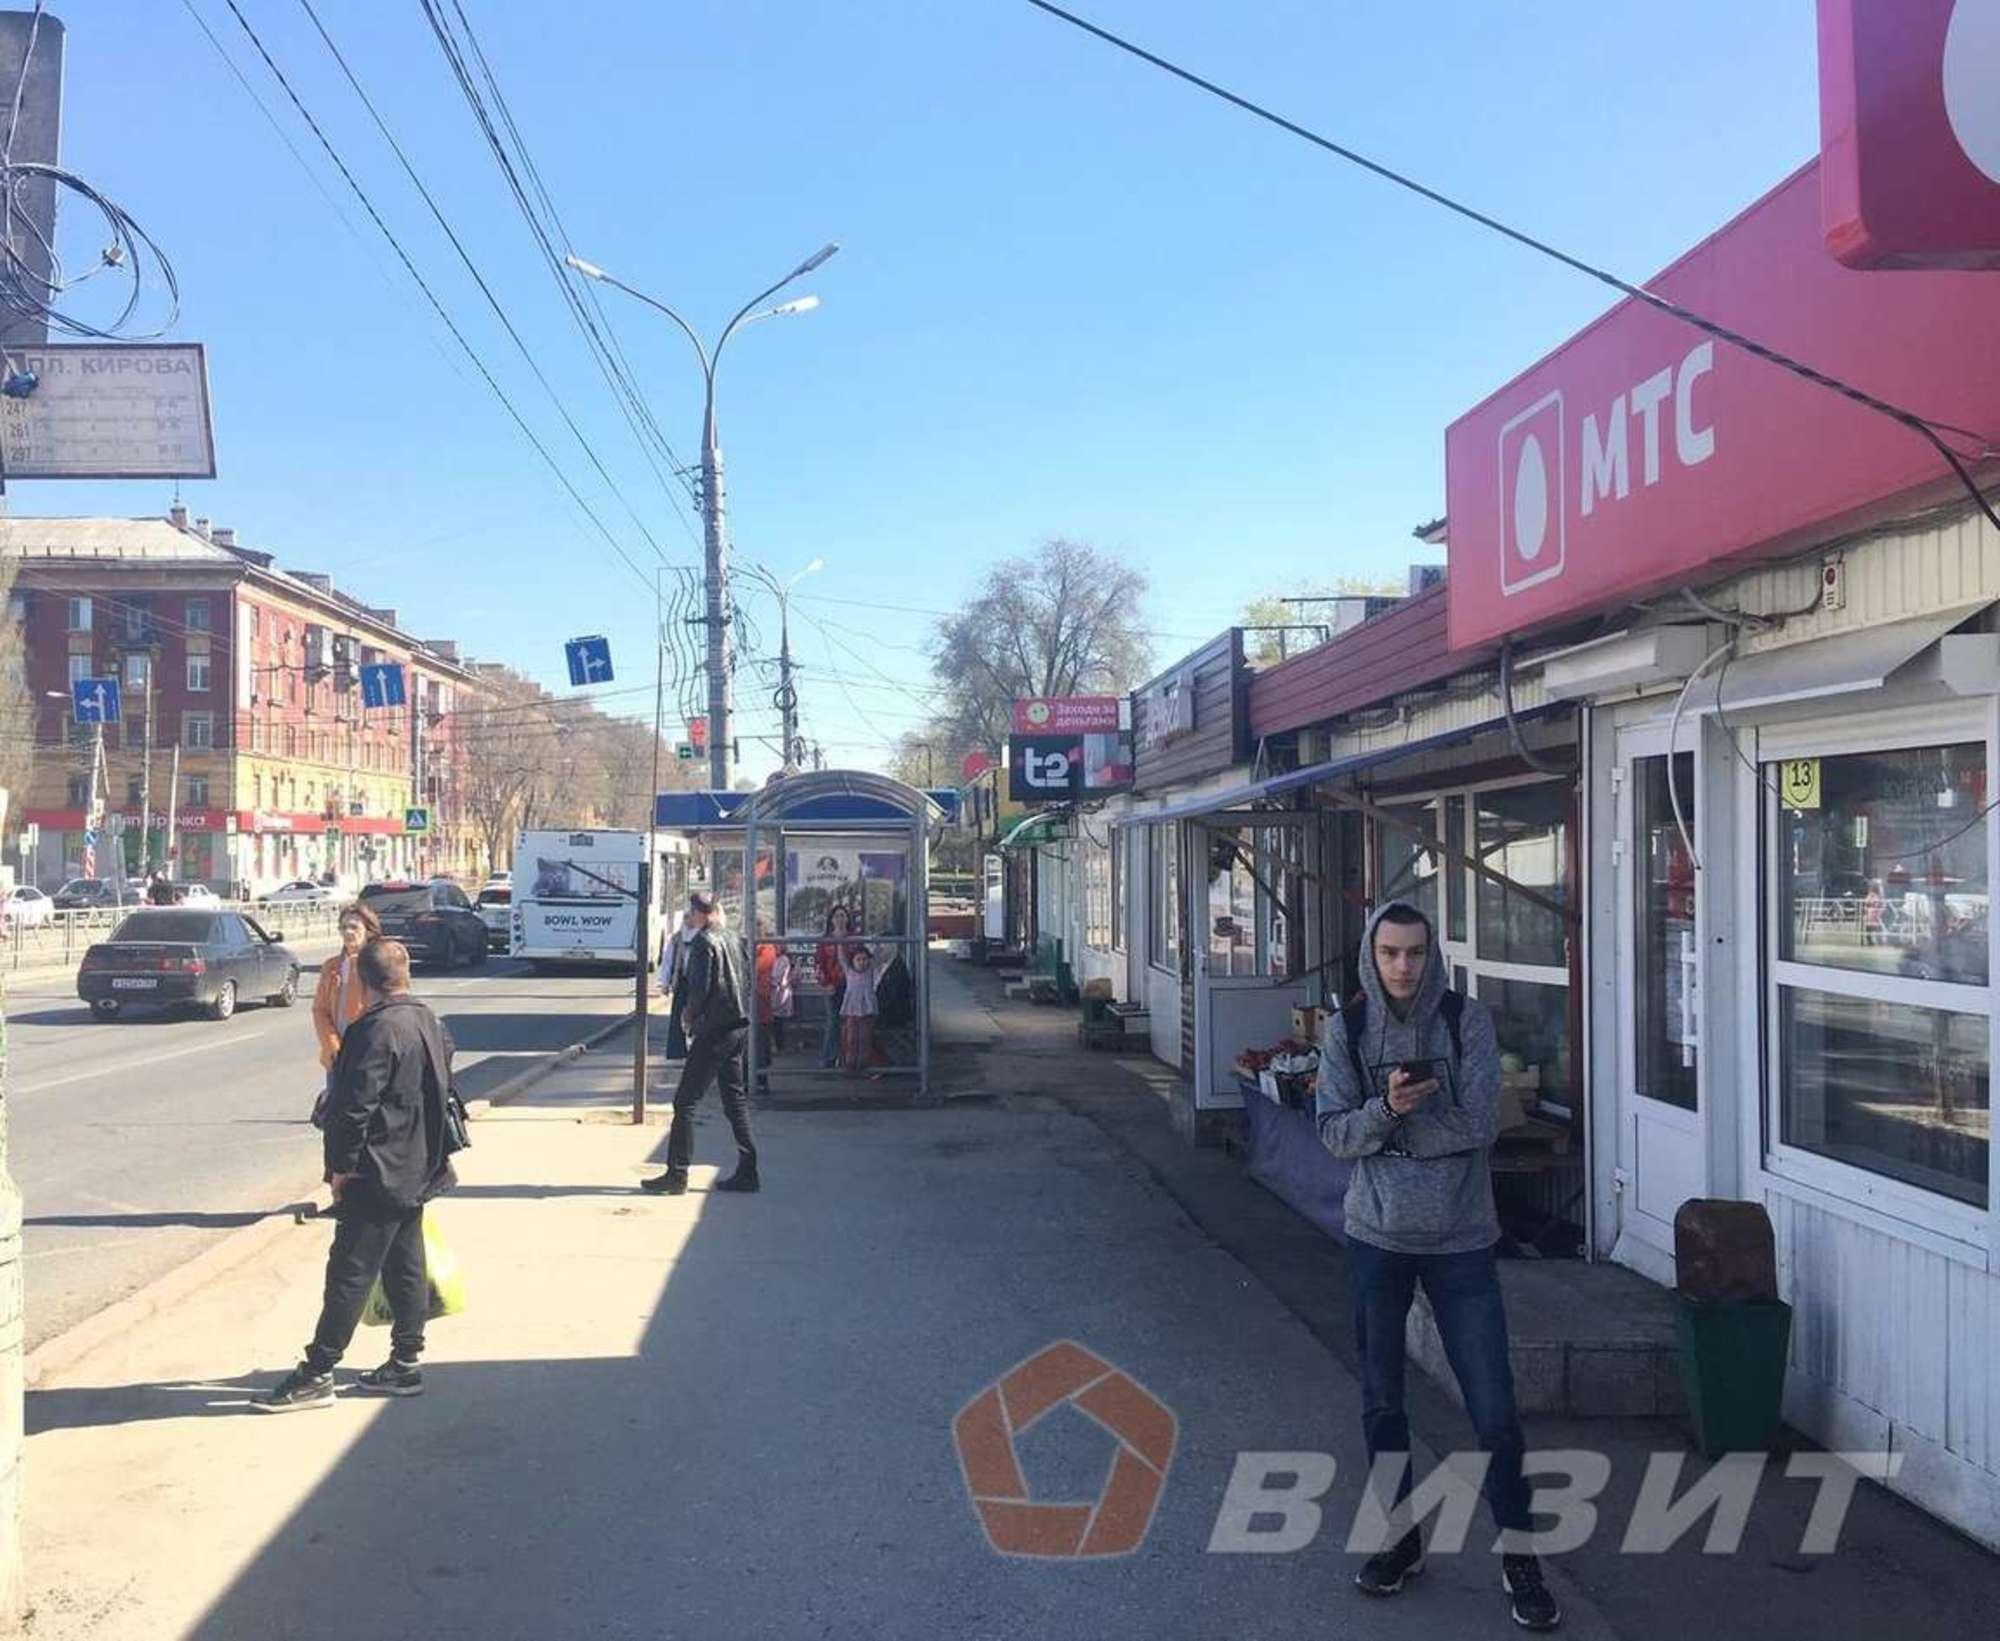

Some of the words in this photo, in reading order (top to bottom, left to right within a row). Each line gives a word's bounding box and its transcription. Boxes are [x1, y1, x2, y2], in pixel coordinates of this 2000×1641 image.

[28, 357, 71, 374] ПЛ.
[80, 357, 192, 374] КИРОВА
[1581, 340, 1715, 516] МТС
[1025, 748, 1069, 787] t2
[1791, 761, 1811, 787] 13
[544, 915, 579, 926] BOWL
[580, 915, 613, 926] WOW
